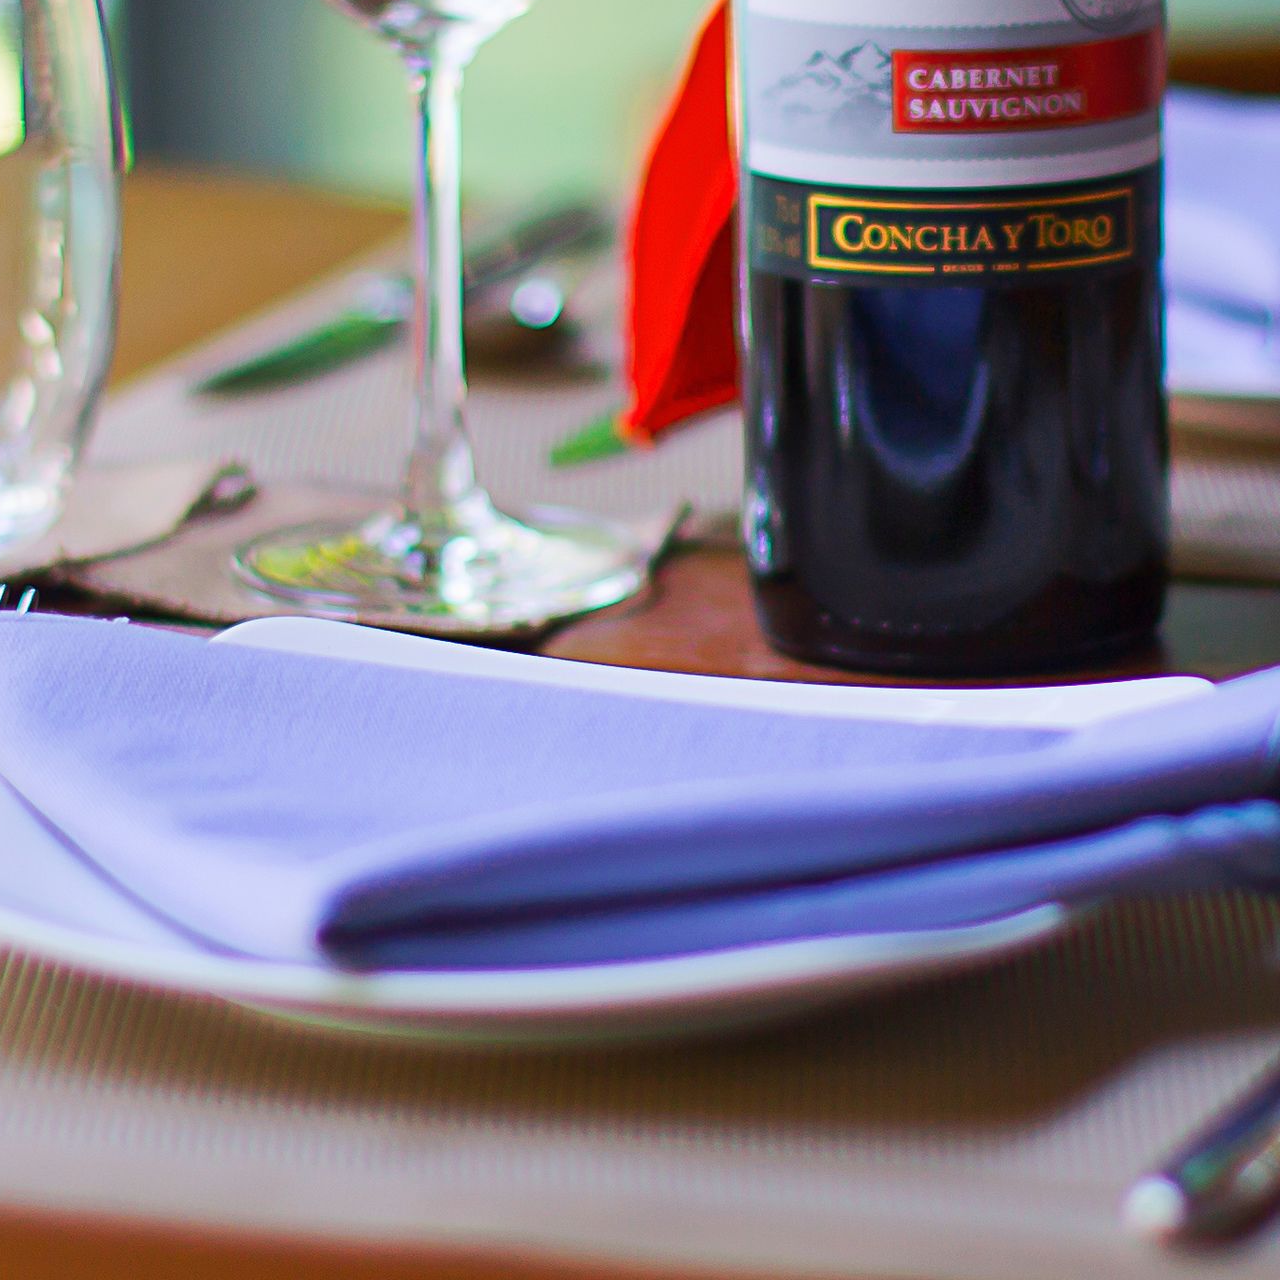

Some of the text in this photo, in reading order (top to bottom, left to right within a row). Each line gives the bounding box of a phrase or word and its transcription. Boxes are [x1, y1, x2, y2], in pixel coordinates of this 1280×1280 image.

[907, 63, 1059, 91] CABERNET
[908, 92, 1083, 120] SAUVIGNON
[832, 214, 995, 252] CONCHA
[1002, 222, 1024, 250] Y
[1027, 212, 1114, 248] TORO
